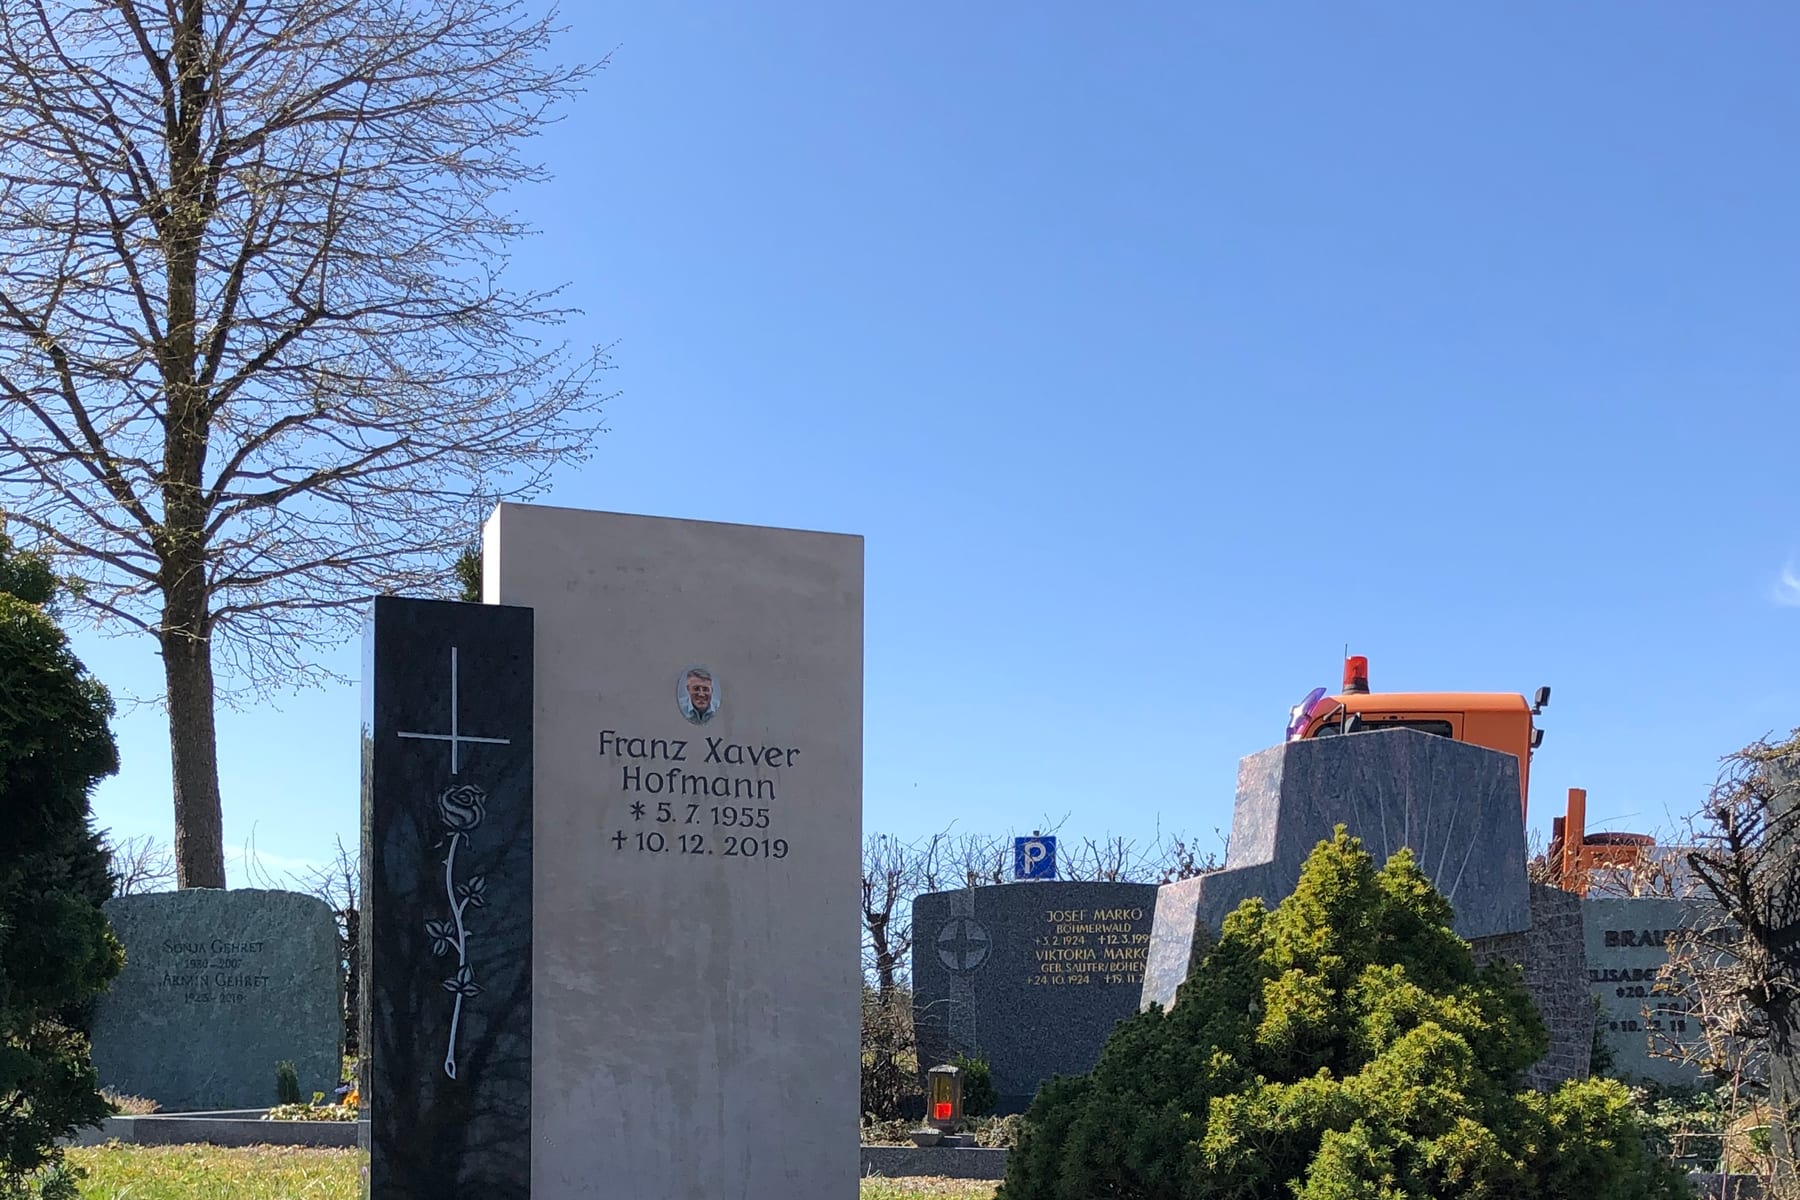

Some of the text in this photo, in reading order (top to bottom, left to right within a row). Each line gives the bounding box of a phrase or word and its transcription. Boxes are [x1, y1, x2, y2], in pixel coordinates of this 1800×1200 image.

[599, 730, 800, 767] Franz Xaver
[622, 765, 776, 800] Hofmann
[1024, 841, 1047, 875] P
[1046, 908, 1143, 922] JOSEF MARKO
[1035, 948, 1096, 961] VIKTORIA
